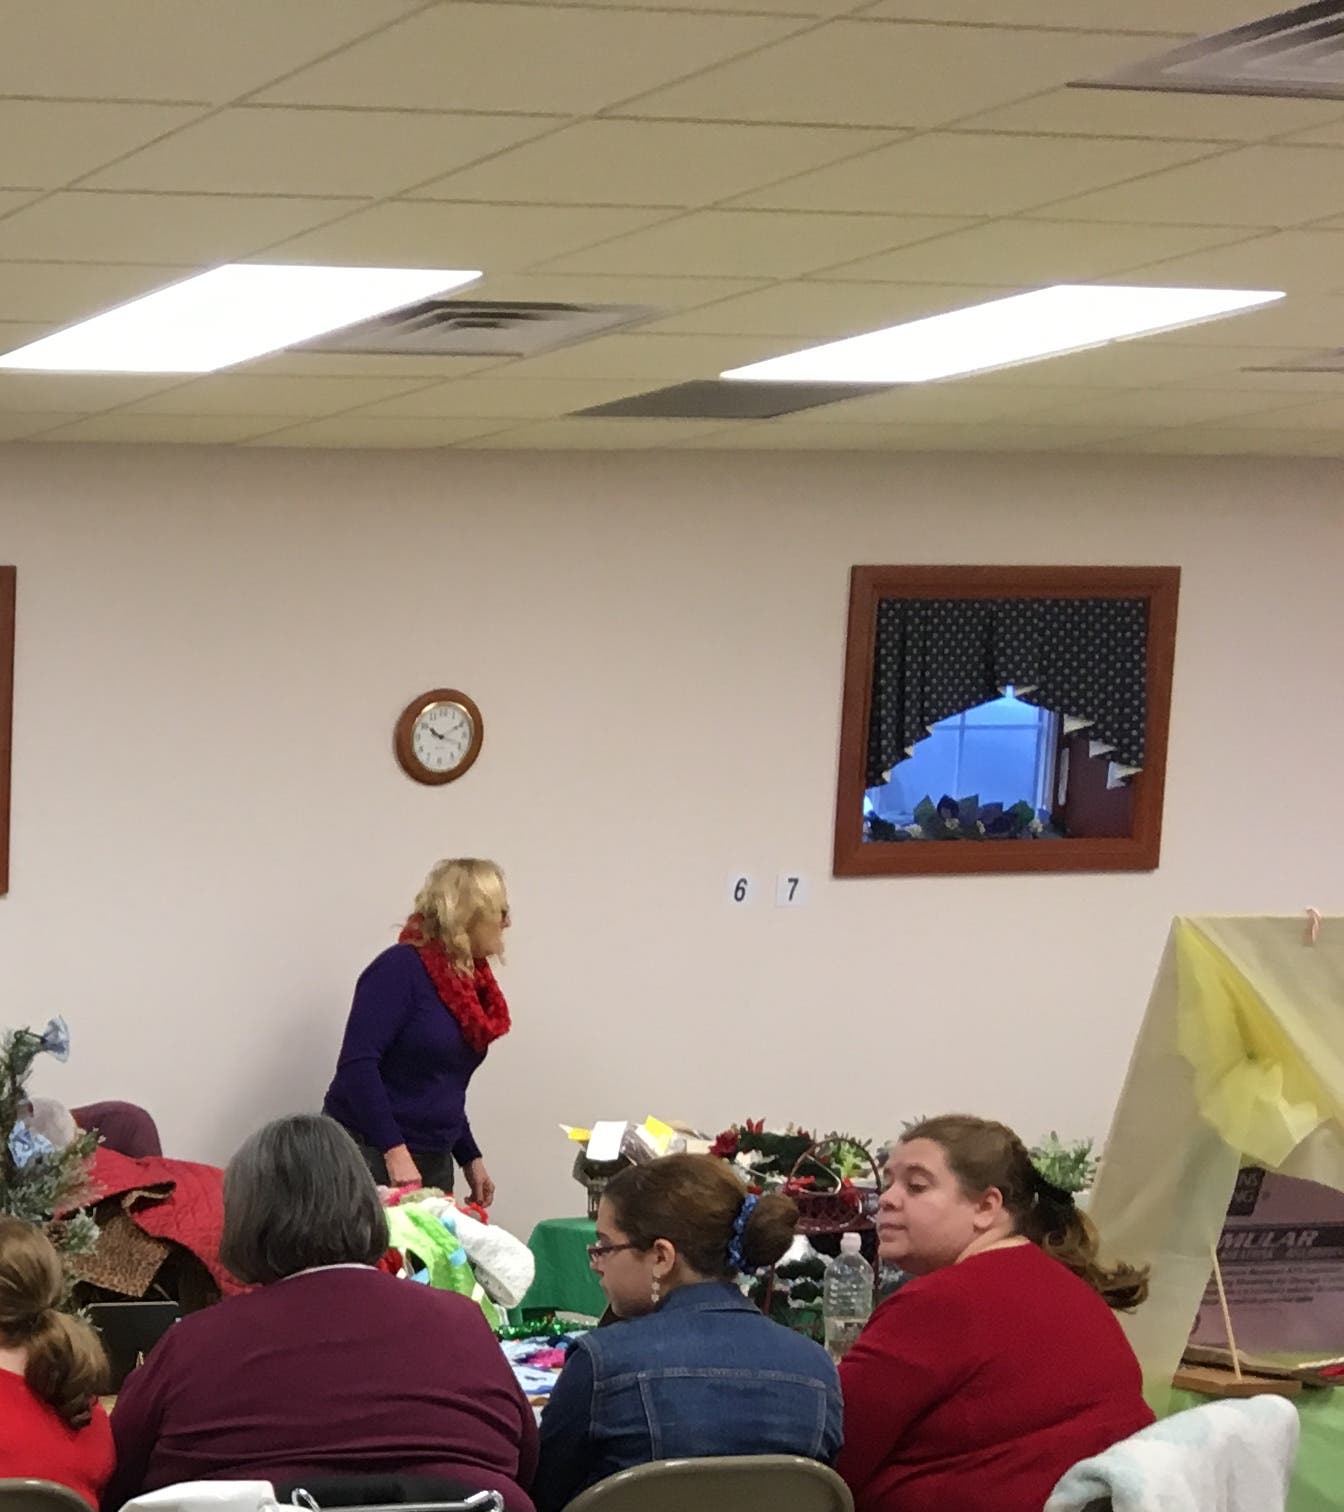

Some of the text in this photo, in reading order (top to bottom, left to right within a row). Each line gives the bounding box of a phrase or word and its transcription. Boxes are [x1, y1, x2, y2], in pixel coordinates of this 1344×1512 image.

[733, 877, 748, 902] 6
[787, 877, 799, 901] 7
[1218, 1230, 1319, 1249] MULAR
